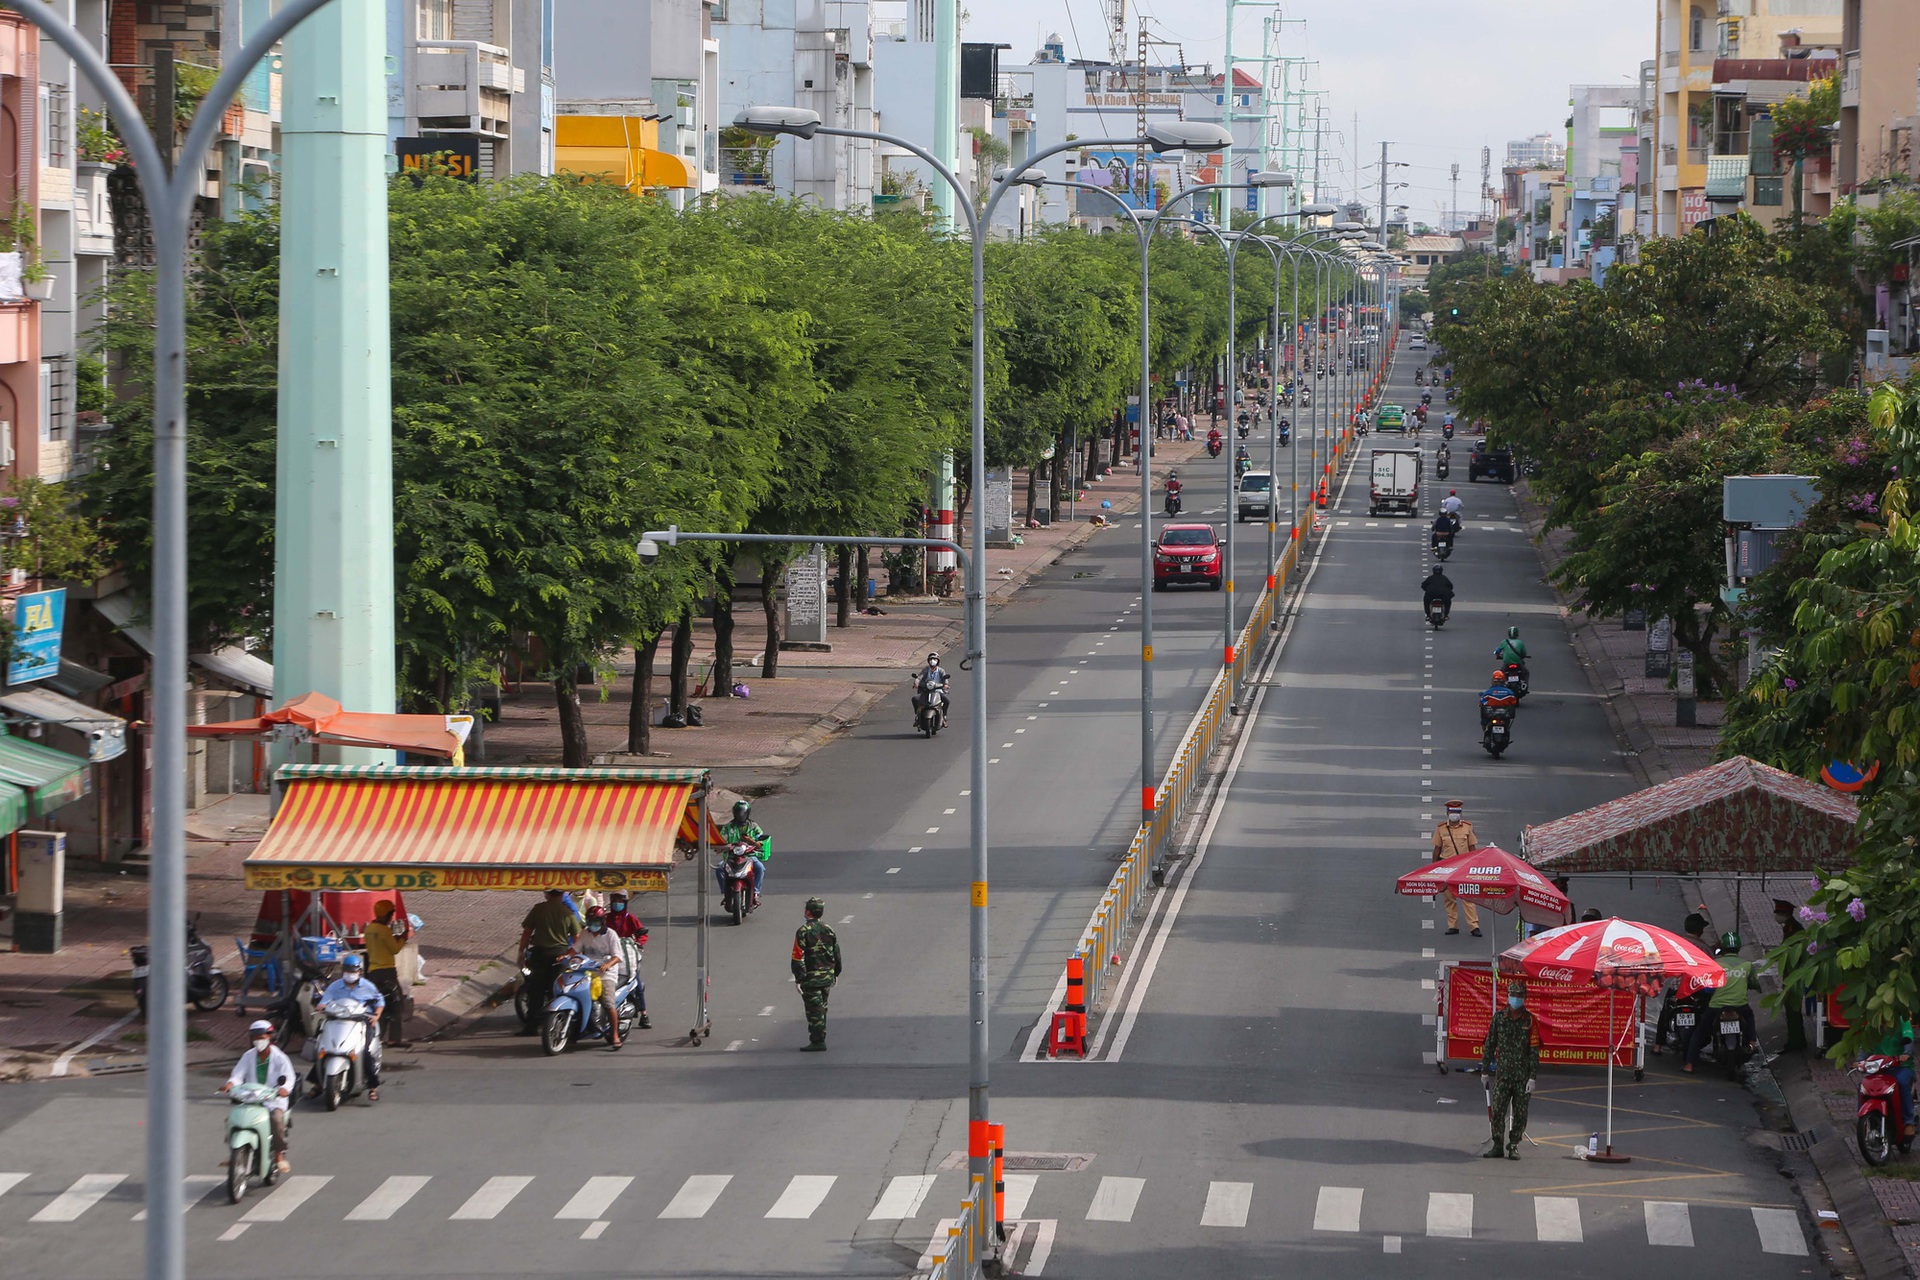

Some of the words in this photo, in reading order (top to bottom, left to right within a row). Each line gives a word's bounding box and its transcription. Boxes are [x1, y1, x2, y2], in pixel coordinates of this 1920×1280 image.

[1105, 93, 1127, 105] Khoa
[1469, 866, 1502, 875] AURA
[394, 870, 437, 887] DÊ
[441, 869, 504, 886] MINH
[1458, 883, 1480, 895] AURA
[1613, 943, 1644, 954] Coca-Cola
[1538, 966, 1575, 982] Coca-Cola
[1724, 967, 1746, 979] Grab
[1552, 1049, 1584, 1059] CHÍNH
[1586, 1049, 1607, 1060] PHỦ
